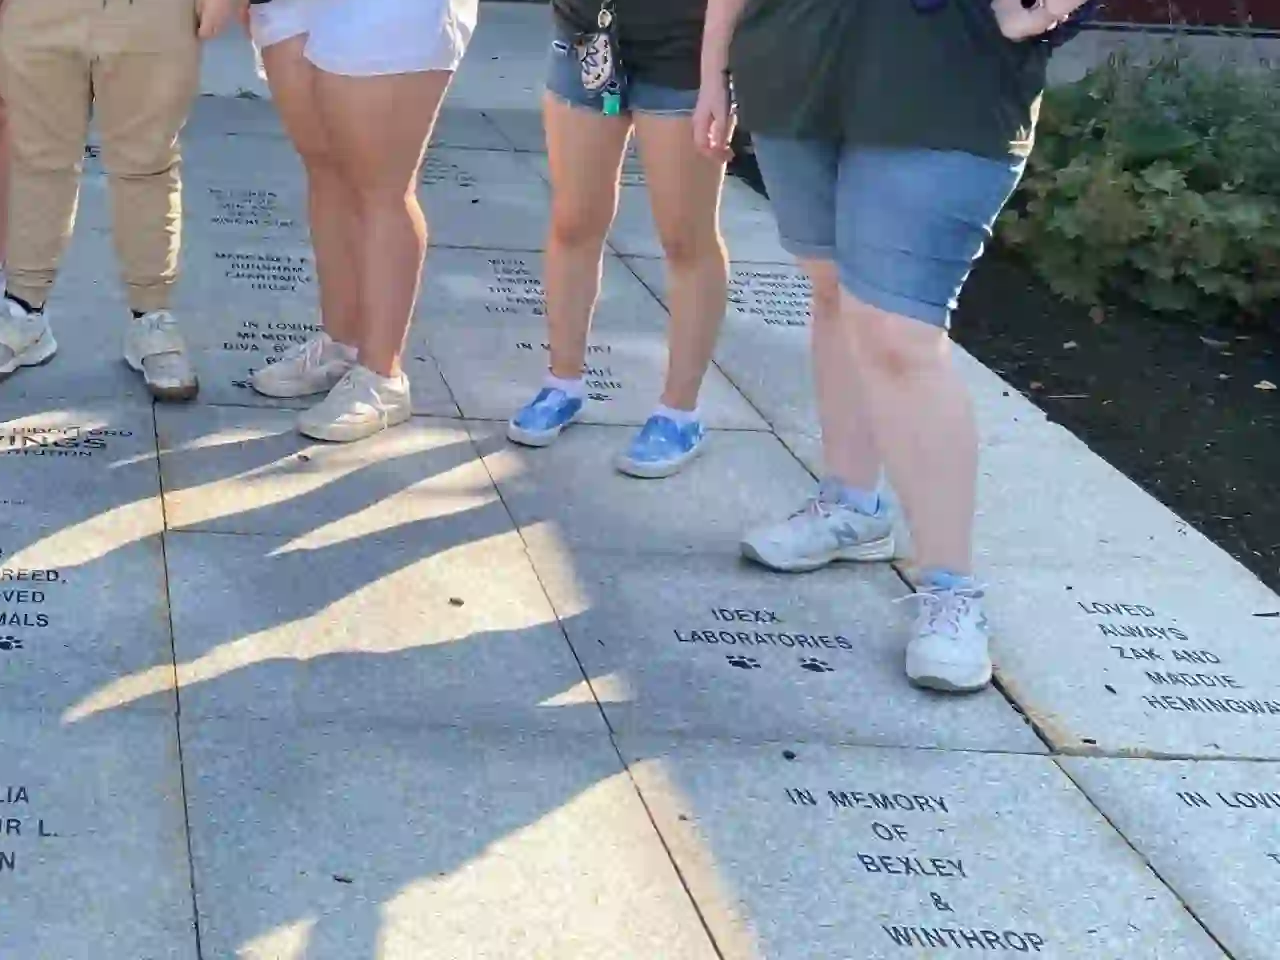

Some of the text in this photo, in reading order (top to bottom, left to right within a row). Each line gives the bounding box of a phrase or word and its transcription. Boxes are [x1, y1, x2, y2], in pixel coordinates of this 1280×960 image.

[1, 569, 68, 584] REED,
[711, 608, 785, 623] IDEXX
[1077, 601, 1155, 617] LOVED
[672, 628, 854, 651] LABORATORIES
[1098, 623, 1189, 641] ALWAYS
[1108, 644, 1222, 664] ZAK AND
[1145, 670, 1246, 689] MADDIE
[1142, 695, 1280, 716] HEMINGWA
[784, 787, 949, 814] IN MEMORY
[1175, 791, 1213, 809] IN
[37, 818, 59, 838] L.
[871, 821, 909, 842] OF
[856, 851, 968, 879] BEXLEY
[930, 891, 955, 913] &
[881, 924, 1048, 953] WINTHROP
